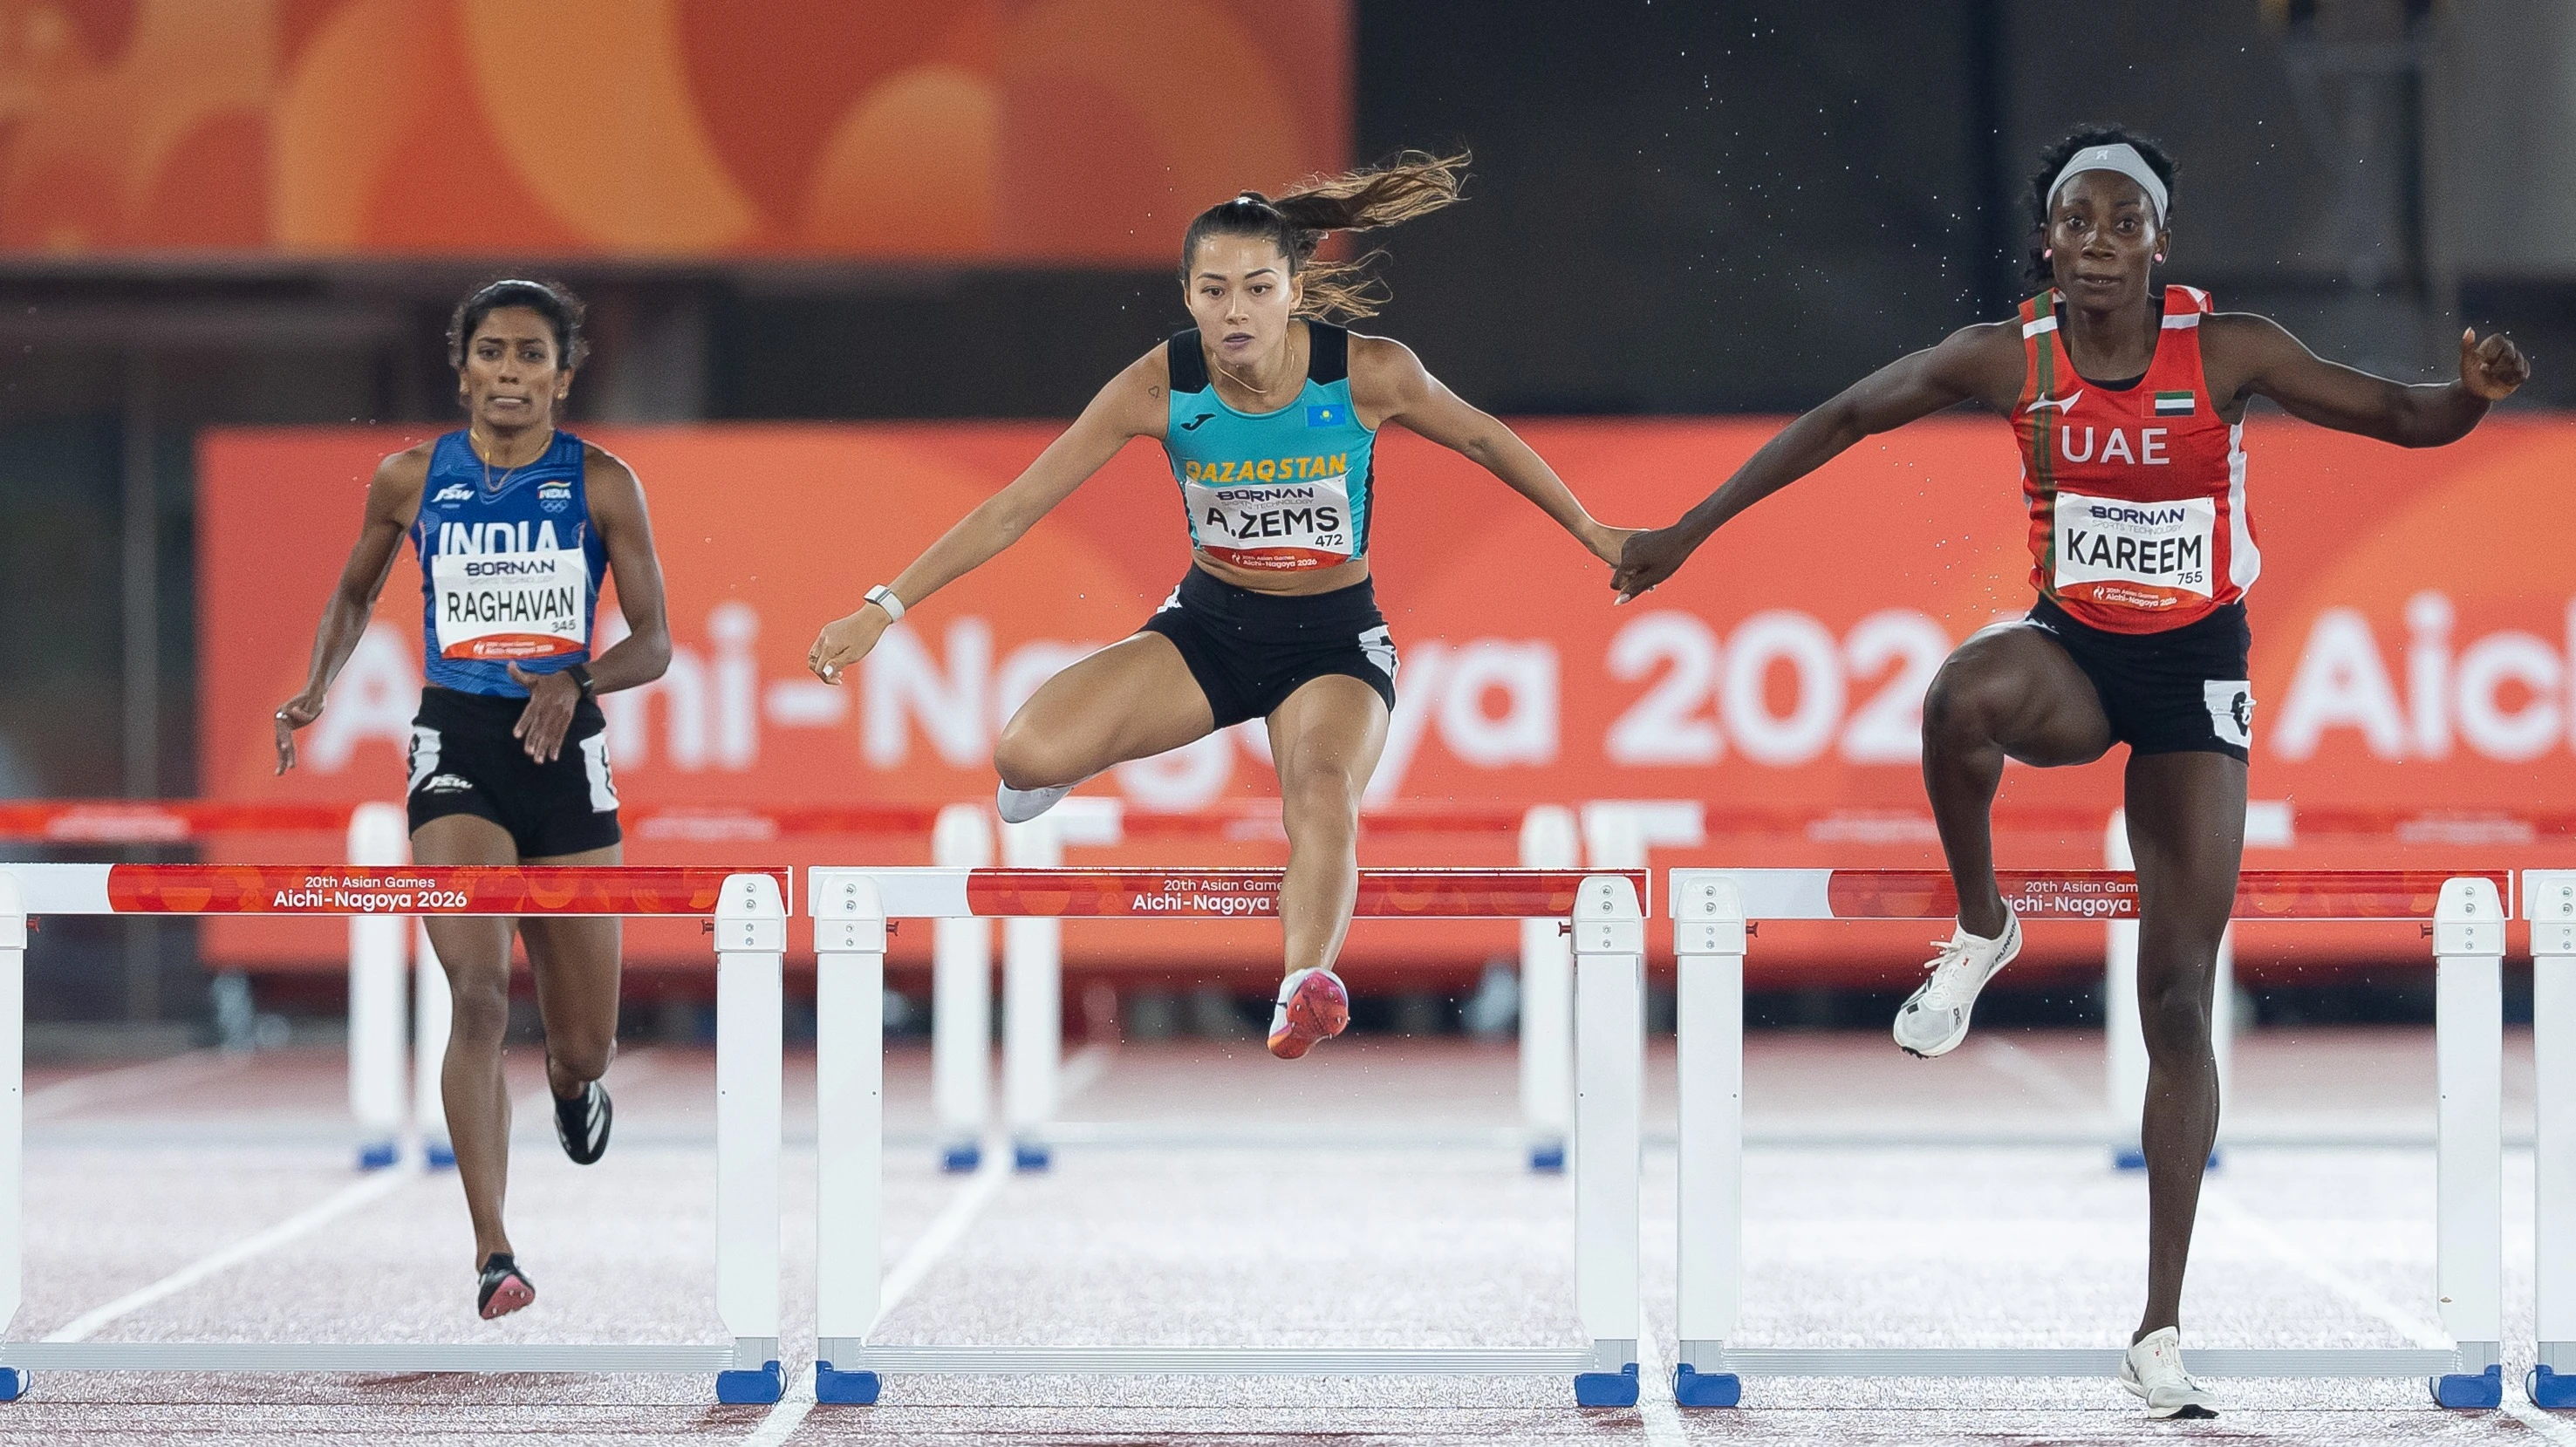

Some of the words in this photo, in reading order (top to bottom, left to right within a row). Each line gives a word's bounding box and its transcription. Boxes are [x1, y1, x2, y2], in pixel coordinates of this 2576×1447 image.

[2060, 425, 2170, 465] UAE
[1185, 454, 1348, 482] QAZAQSTAN
[1215, 488, 1314, 502] BORNAN
[1254, 499, 1315, 509] TECHNOLOGY
[1206, 507, 1340, 540] A.ZEMS
[2088, 505, 2185, 526] BORNAN
[438, 520, 560, 556] INDIA
[2092, 520, 2125, 531] SPORTS
[2128, 524, 2184, 536] TECHNOLOGY
[1315, 534, 1343, 547] 472
[2067, 528, 2203, 575] KAREEM
[463, 559, 556, 577] BORNAN
[1243, 560, 1296, 569] Aichi-Nagoya
[1297, 558, 1318, 567] 2026
[2177, 570, 2204, 585] 755
[446, 586, 575, 623] RAGHAVAN
[2106, 593, 2159, 608] Aichi-Nagoya
[550, 619, 577, 633] 345
[1603, 608, 1958, 766] 202
[2270, 590, 2576, 763] Aic
[304, 876, 338, 888] 20th
[342, 876, 381, 888] Asian
[385, 876, 436, 888] Games
[1163, 879, 1197, 891] 20th
[1200, 879, 1240, 891] Asian
[1243, 879, 1282, 891] Game
[2025, 881, 2058, 893] 20th
[2062, 881, 2101, 893] Asian
[2105, 881, 2139, 893] Gam
[273, 890, 413, 912] Aichi-Nagoya
[417, 891, 468, 908] 2026
[1132, 892, 1270, 915] Aichi-Nagoya
[2008, 894, 2132, 917] ichi-Nagoya
[1995, 918, 2017, 962] RUNNIN
